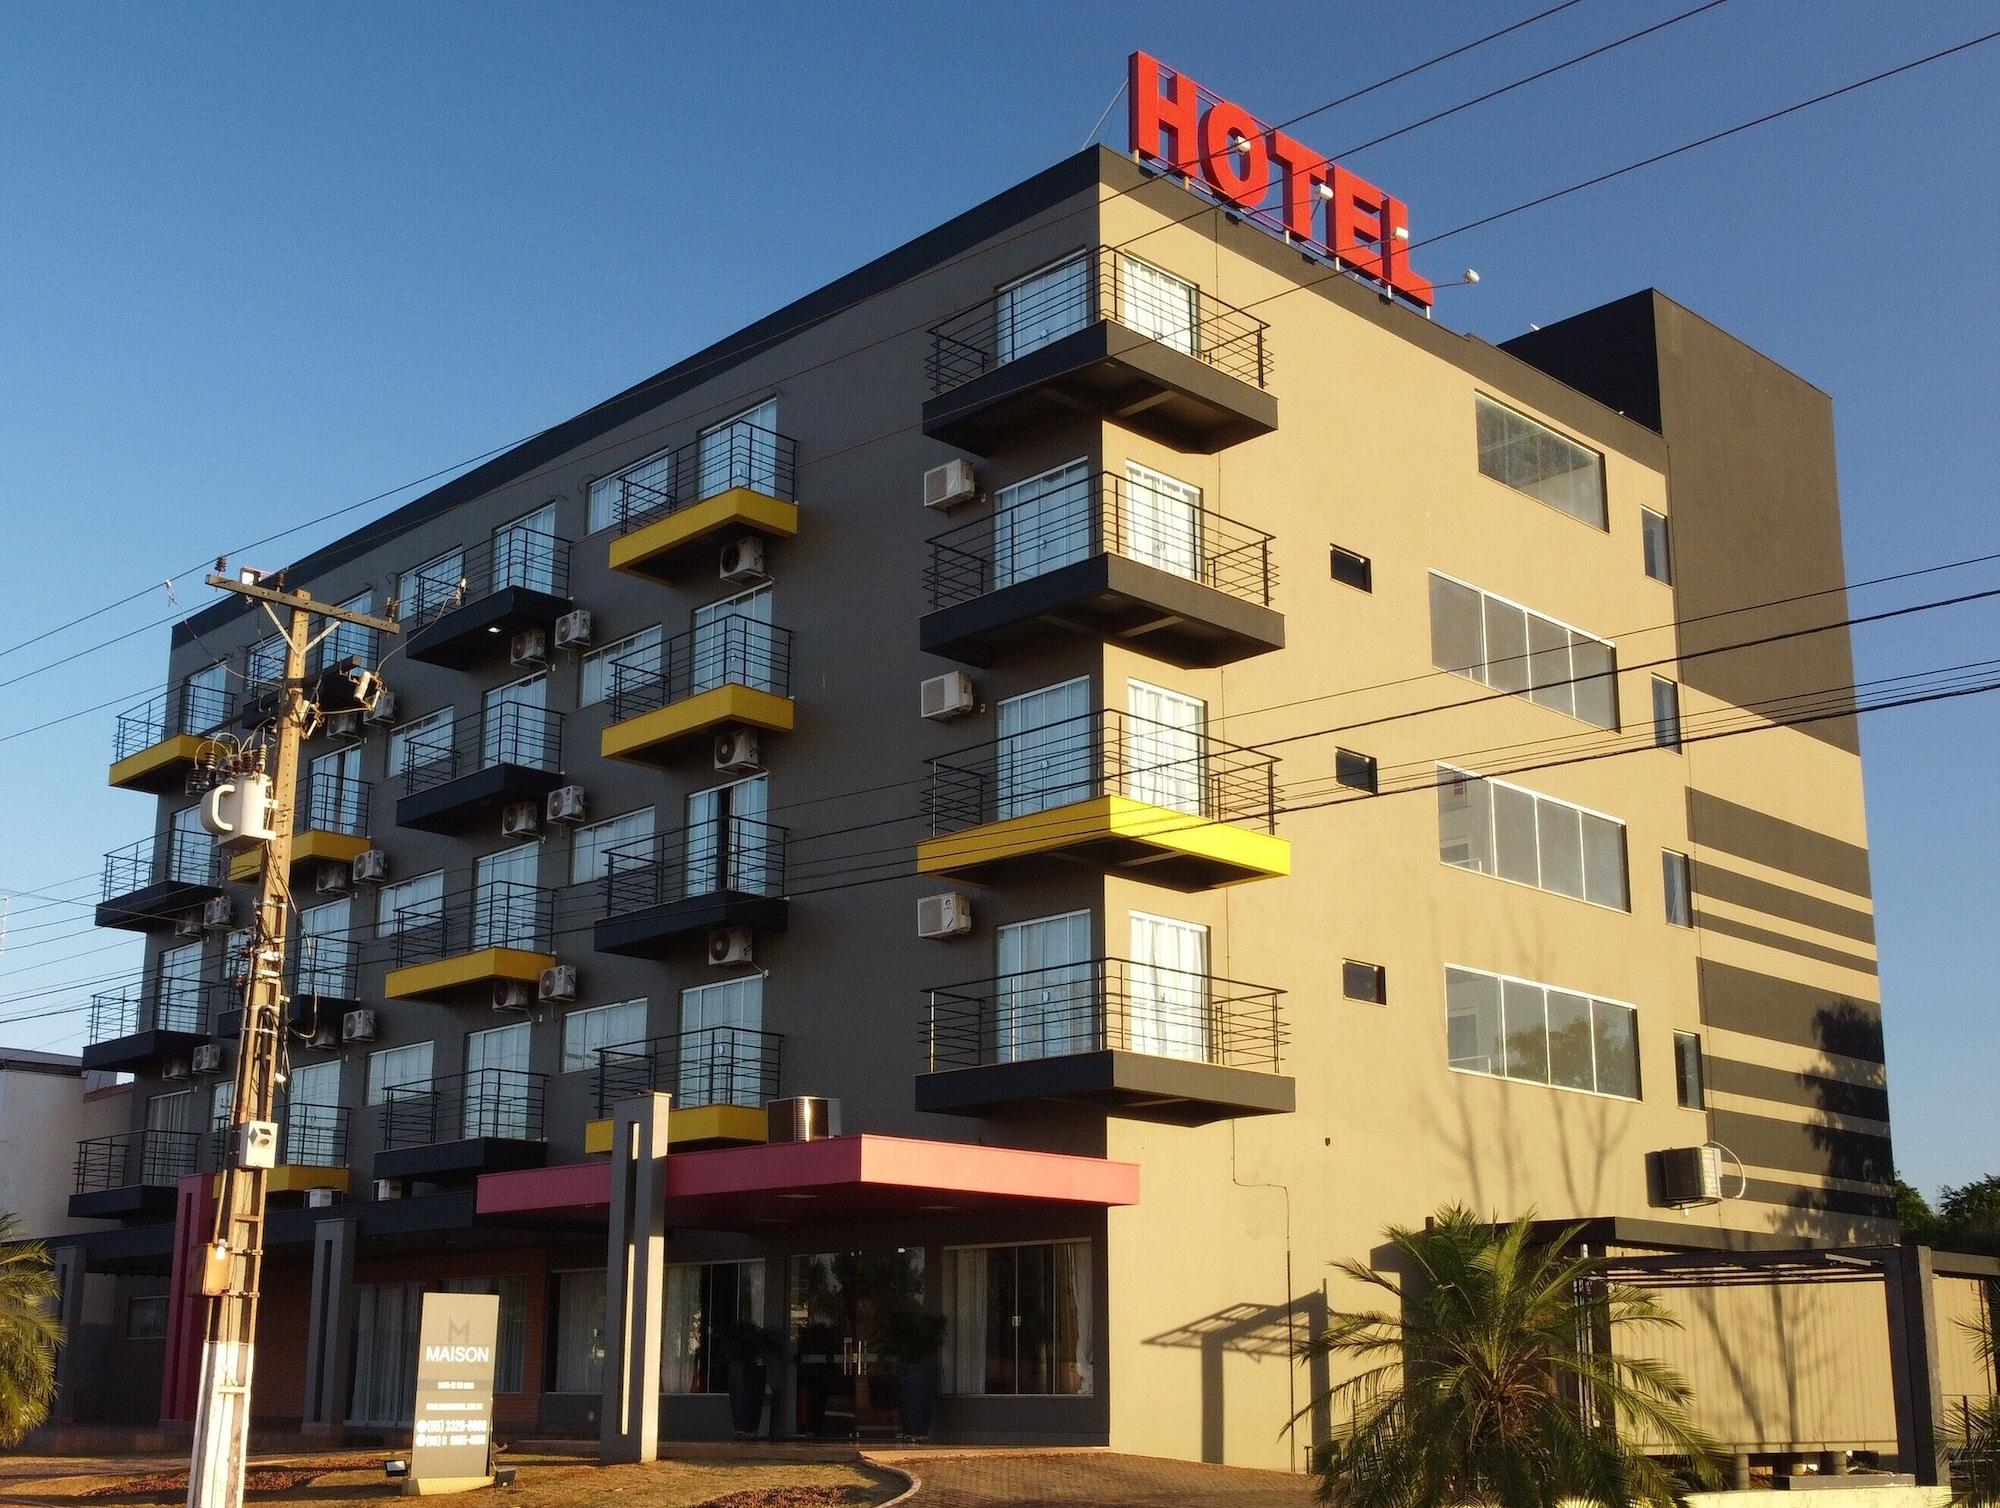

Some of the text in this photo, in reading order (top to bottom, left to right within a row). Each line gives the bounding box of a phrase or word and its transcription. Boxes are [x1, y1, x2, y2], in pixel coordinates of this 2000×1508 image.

[1128, 50, 1435, 308] HOTEL
[447, 1315, 471, 1344] M
[425, 1345, 489, 1363] MAISON
